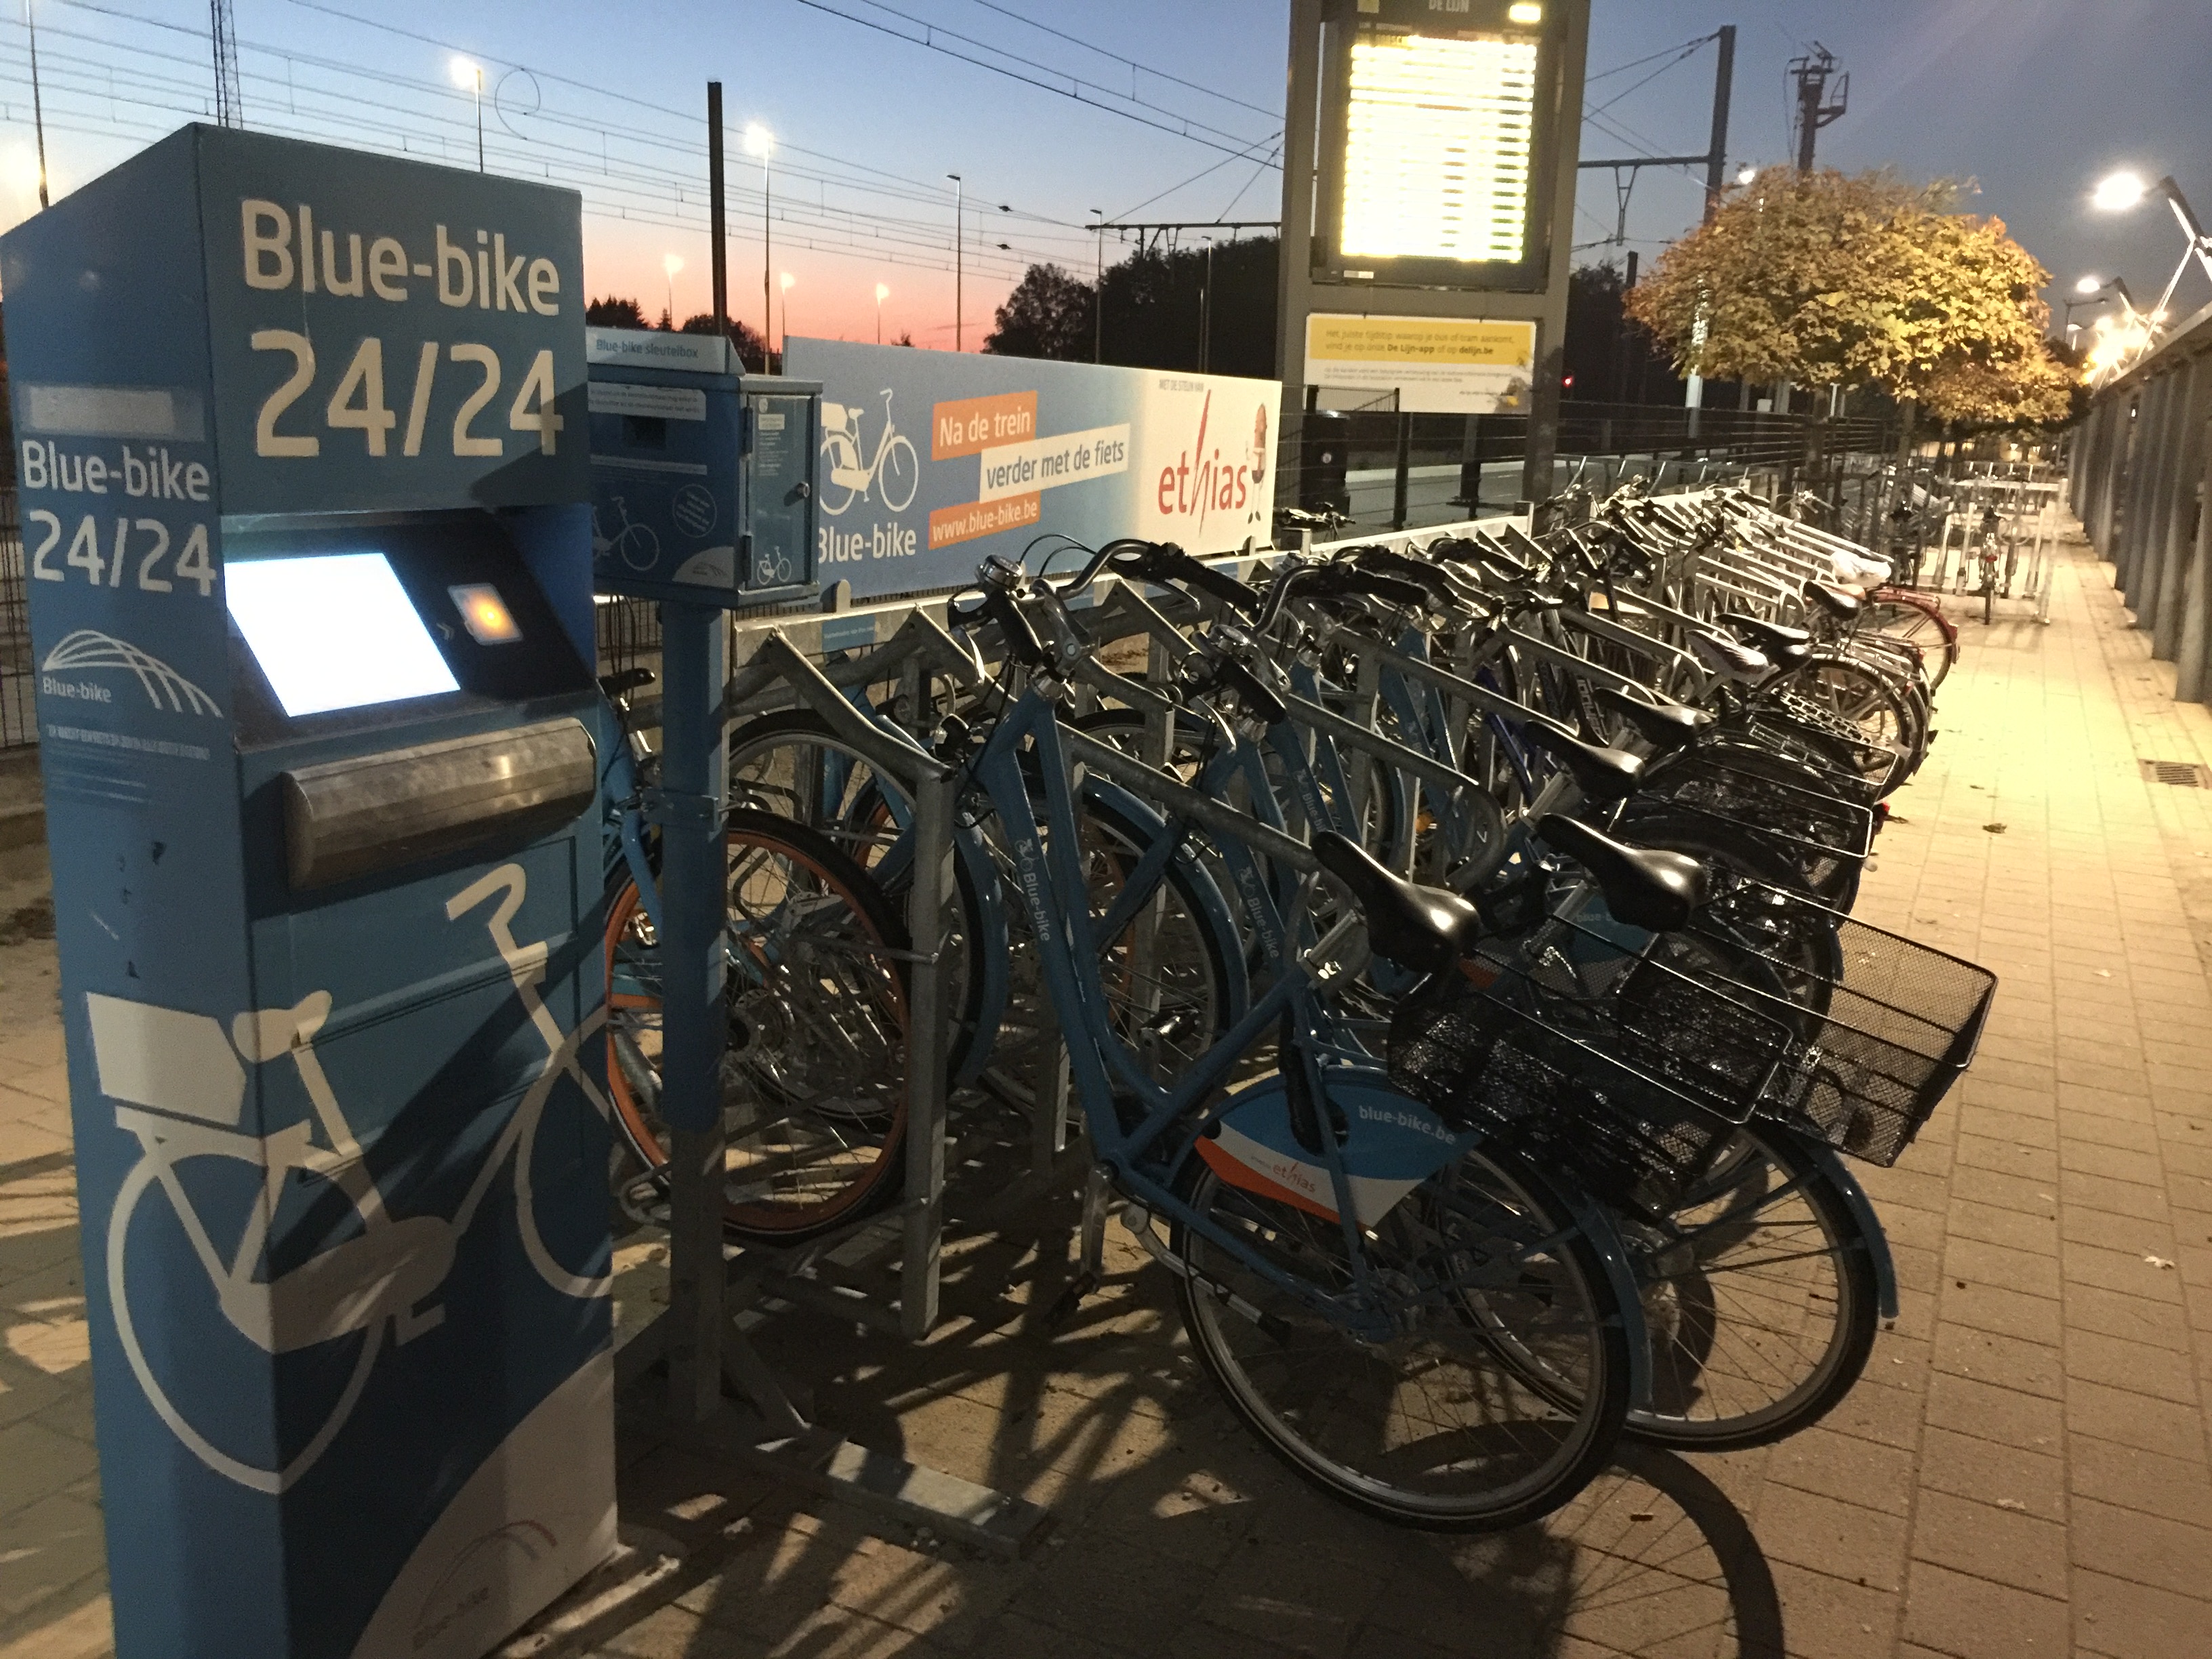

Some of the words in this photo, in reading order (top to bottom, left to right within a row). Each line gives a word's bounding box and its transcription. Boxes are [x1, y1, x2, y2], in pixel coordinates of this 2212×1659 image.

[242, 199, 560, 316] Blue-bike
[596, 339, 642, 354] Blue-bike
[645, 343, 699, 359] sleutelbox
[1387, 343, 1397, 352] De
[1401, 344, 1435, 354] Lijn-app
[1459, 346, 1494, 356] delijn.be
[251, 329, 563, 458] 24/24
[940, 417, 962, 447] Na
[968, 412, 989, 442] de
[994, 406, 1030, 437] trein
[22, 440, 210, 501] Blue-bike
[987, 455, 1037, 489] verder
[1041, 450, 1069, 476] met
[1073, 444, 1090, 471] de
[1094, 440, 1124, 466] fiets
[1158, 389, 1247, 537] ethias
[933, 499, 1038, 542] www.blue-bike.be
[30, 509, 217, 596] 24/24
[42, 676, 112, 703] Blue-bike
[1023, 872, 1050, 941] Blue-bike
[1247, 897, 1279, 958] Blue-bike
[1359, 1105, 1456, 1145] blue-bike.be
[1273, 1161, 1315, 1193] ethias
